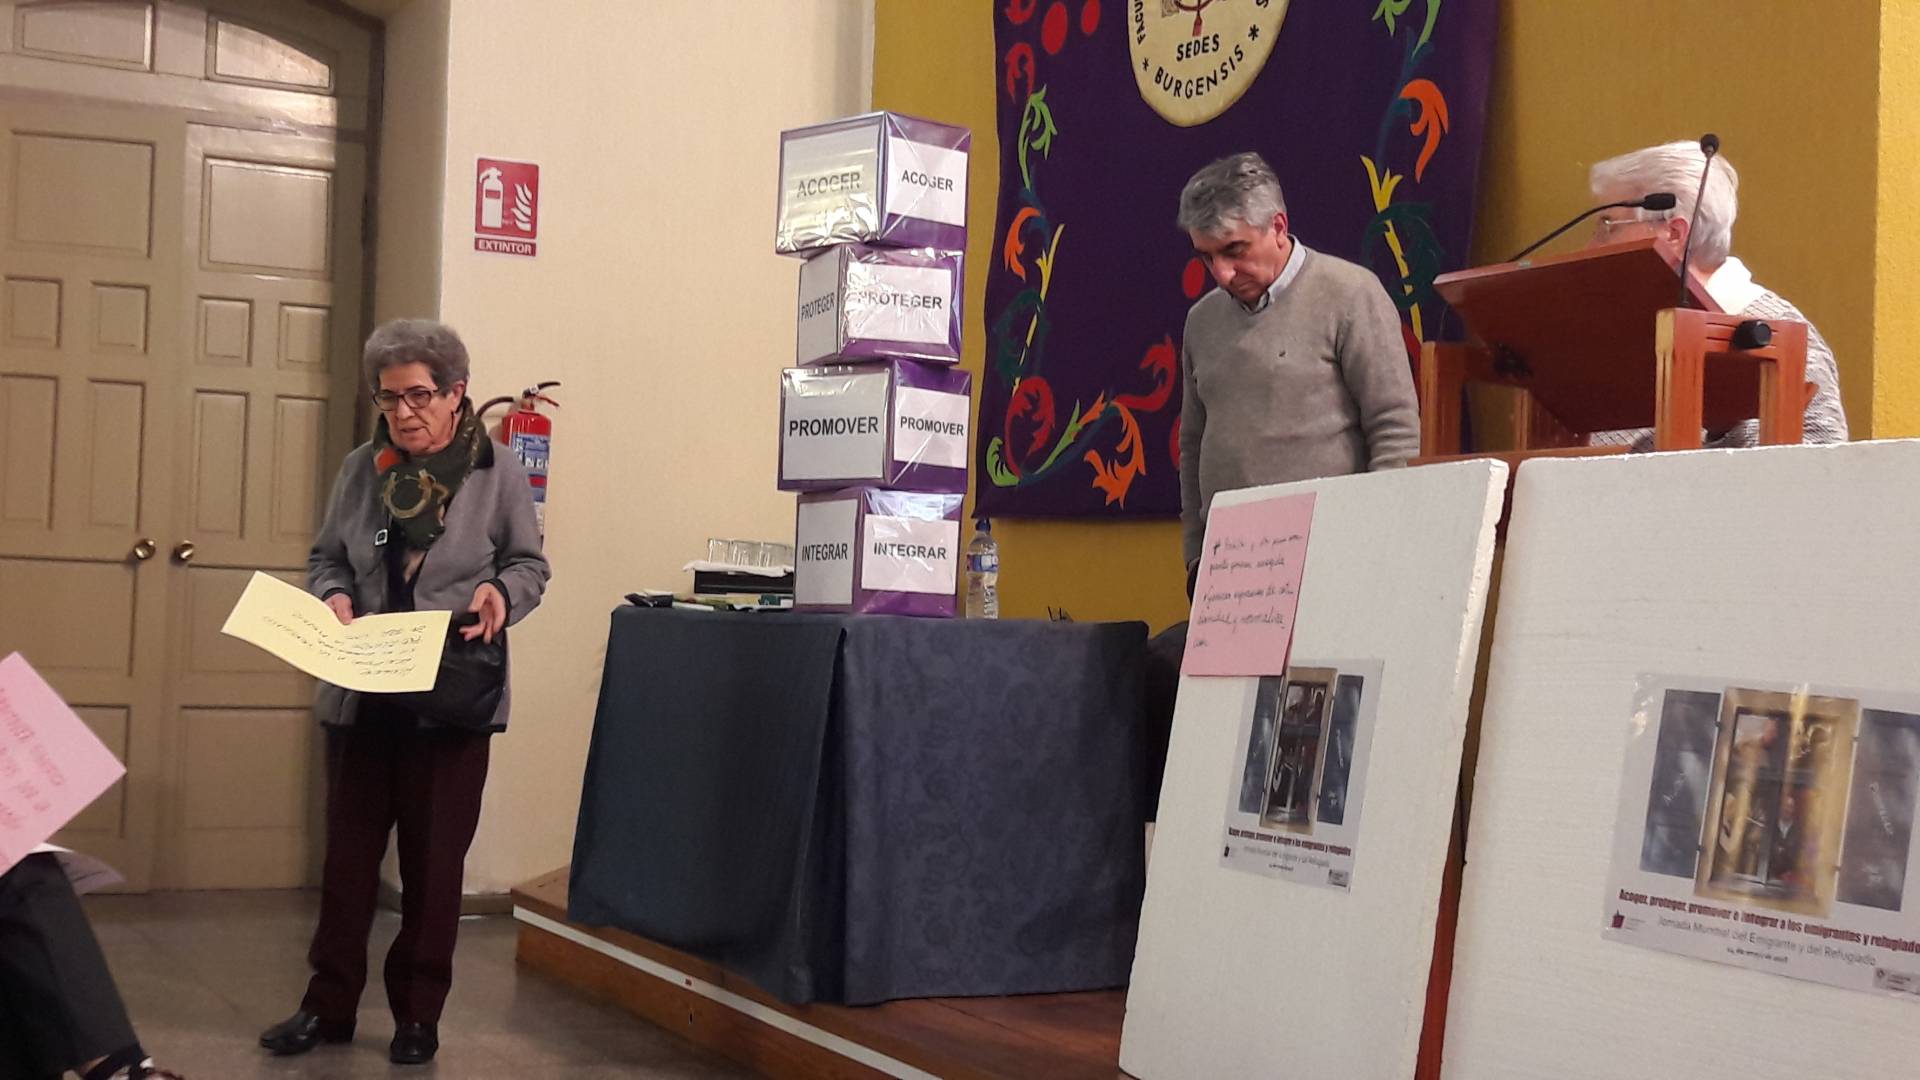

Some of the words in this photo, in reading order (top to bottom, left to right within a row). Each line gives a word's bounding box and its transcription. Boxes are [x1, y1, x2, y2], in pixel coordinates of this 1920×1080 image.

[1135, 0, 1146, 45] FACU
[1176, 33, 1220, 62] SEDES
[1154, 44, 1244, 99] BURGENSIS
[797, 172, 860, 198] ACOGER
[901, 169, 954, 192] ACOGER
[478, 239, 532, 254] EXTINTOR
[801, 292, 835, 321] PROTEGER
[789, 416, 879, 437] PROMOVER
[900, 416, 964, 437] PROMOVER
[801, 543, 848, 562] INTEGRAR
[873, 542, 946, 560] INTEGRAR
[1787, 918, 1802, 933] los
[1863, 934, 1870, 946] y
